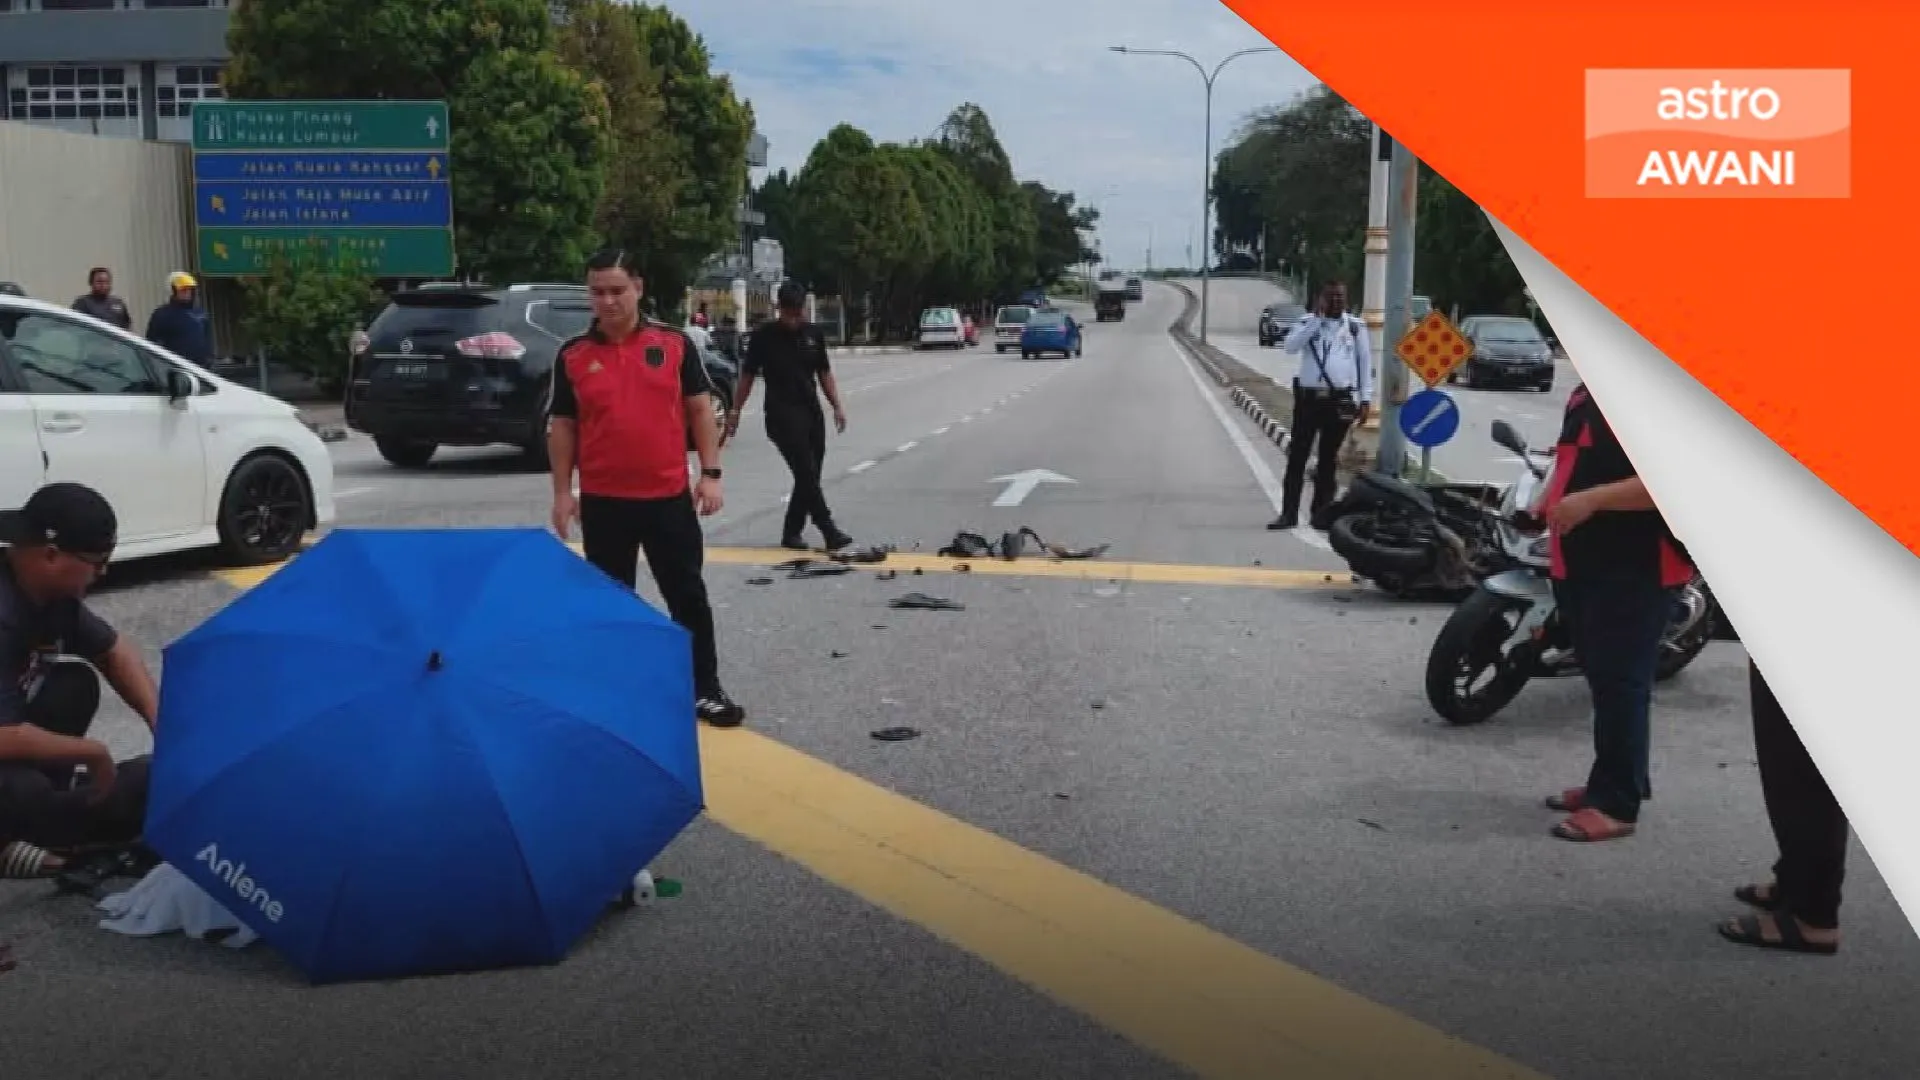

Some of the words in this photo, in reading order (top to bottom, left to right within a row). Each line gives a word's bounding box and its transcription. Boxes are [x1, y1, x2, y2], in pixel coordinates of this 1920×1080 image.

[236, 110, 285, 125] Pulau
[293, 110, 353, 126] Pinang
[293, 130, 360, 143] Lumpur
[242, 208, 288, 220] Jalan
[194, 842, 284, 923] Anlene
